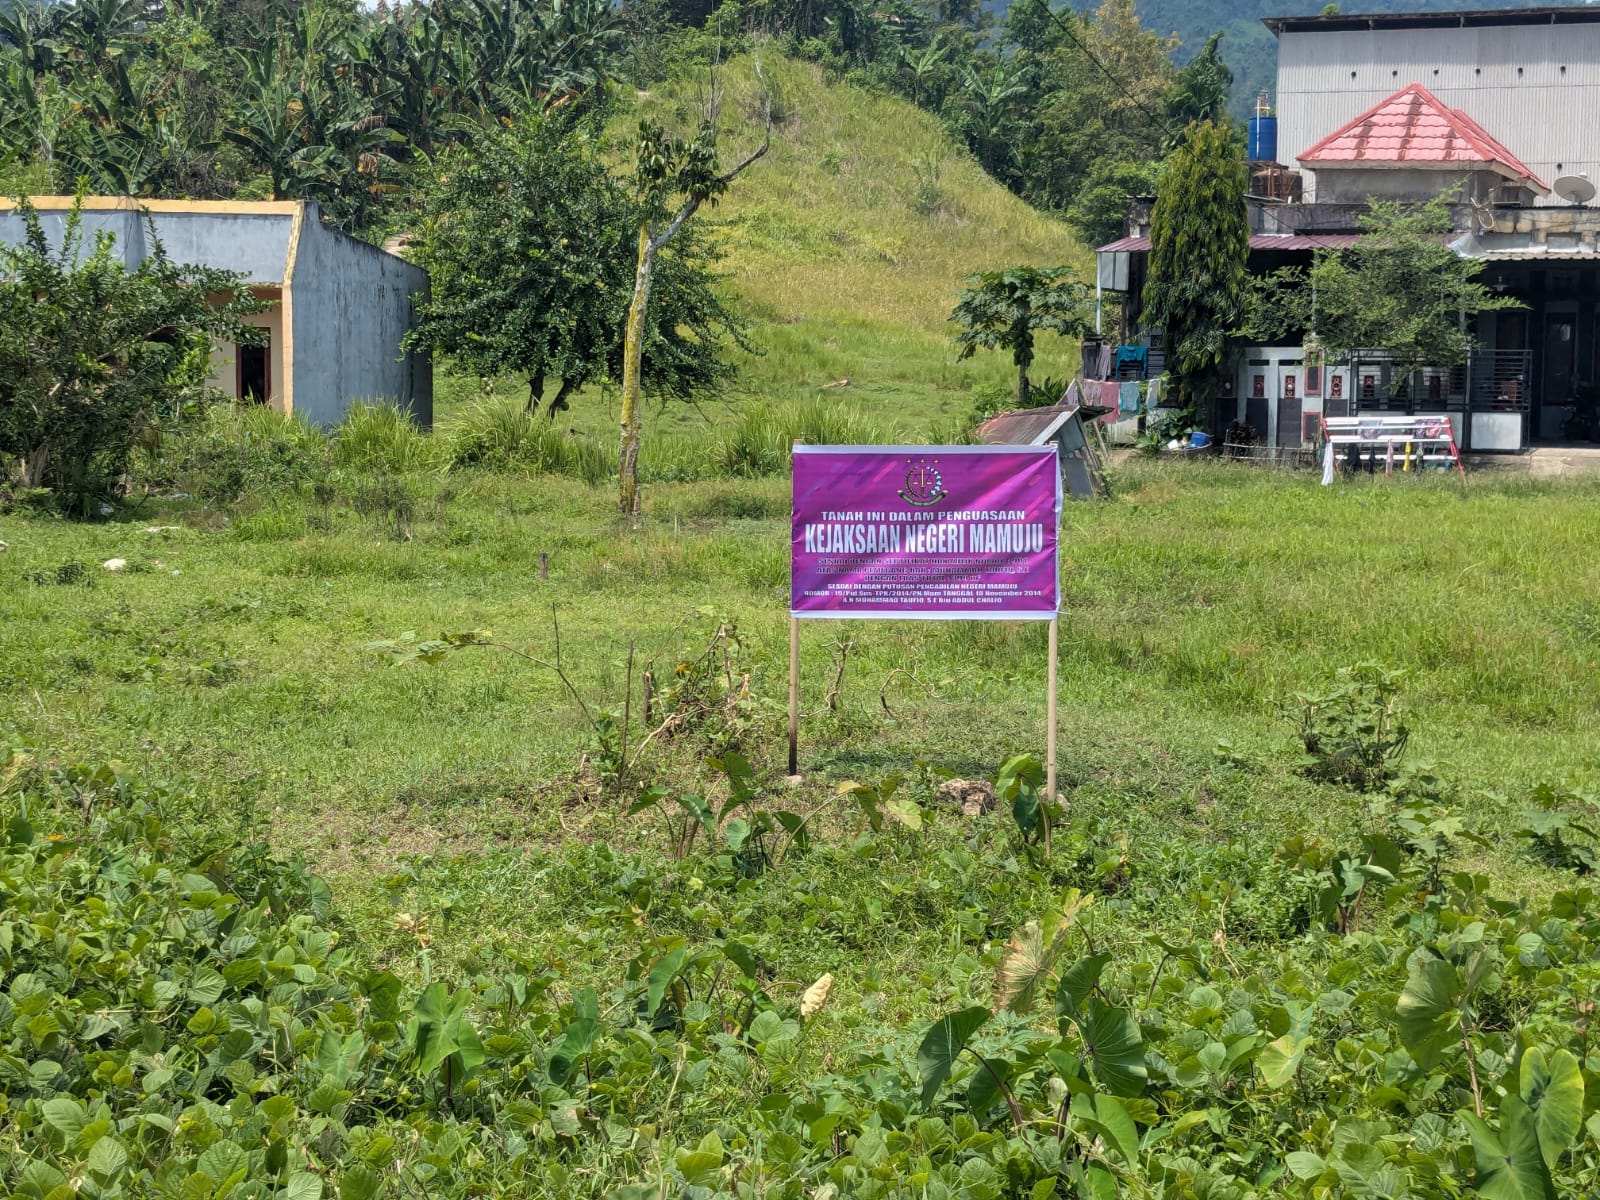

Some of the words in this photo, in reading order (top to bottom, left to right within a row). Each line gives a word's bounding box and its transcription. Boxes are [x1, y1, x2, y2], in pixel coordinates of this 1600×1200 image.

[821, 511, 864, 521] TANAH
[867, 511, 885, 521] INI
[889, 511, 934, 522] DALAM
[938, 511, 1025, 520] PENGUASAAN
[805, 524, 900, 554] KEJAKSAAN
[905, 524, 964, 553] NEGERI
[969, 524, 1043, 553] MAMUJU
